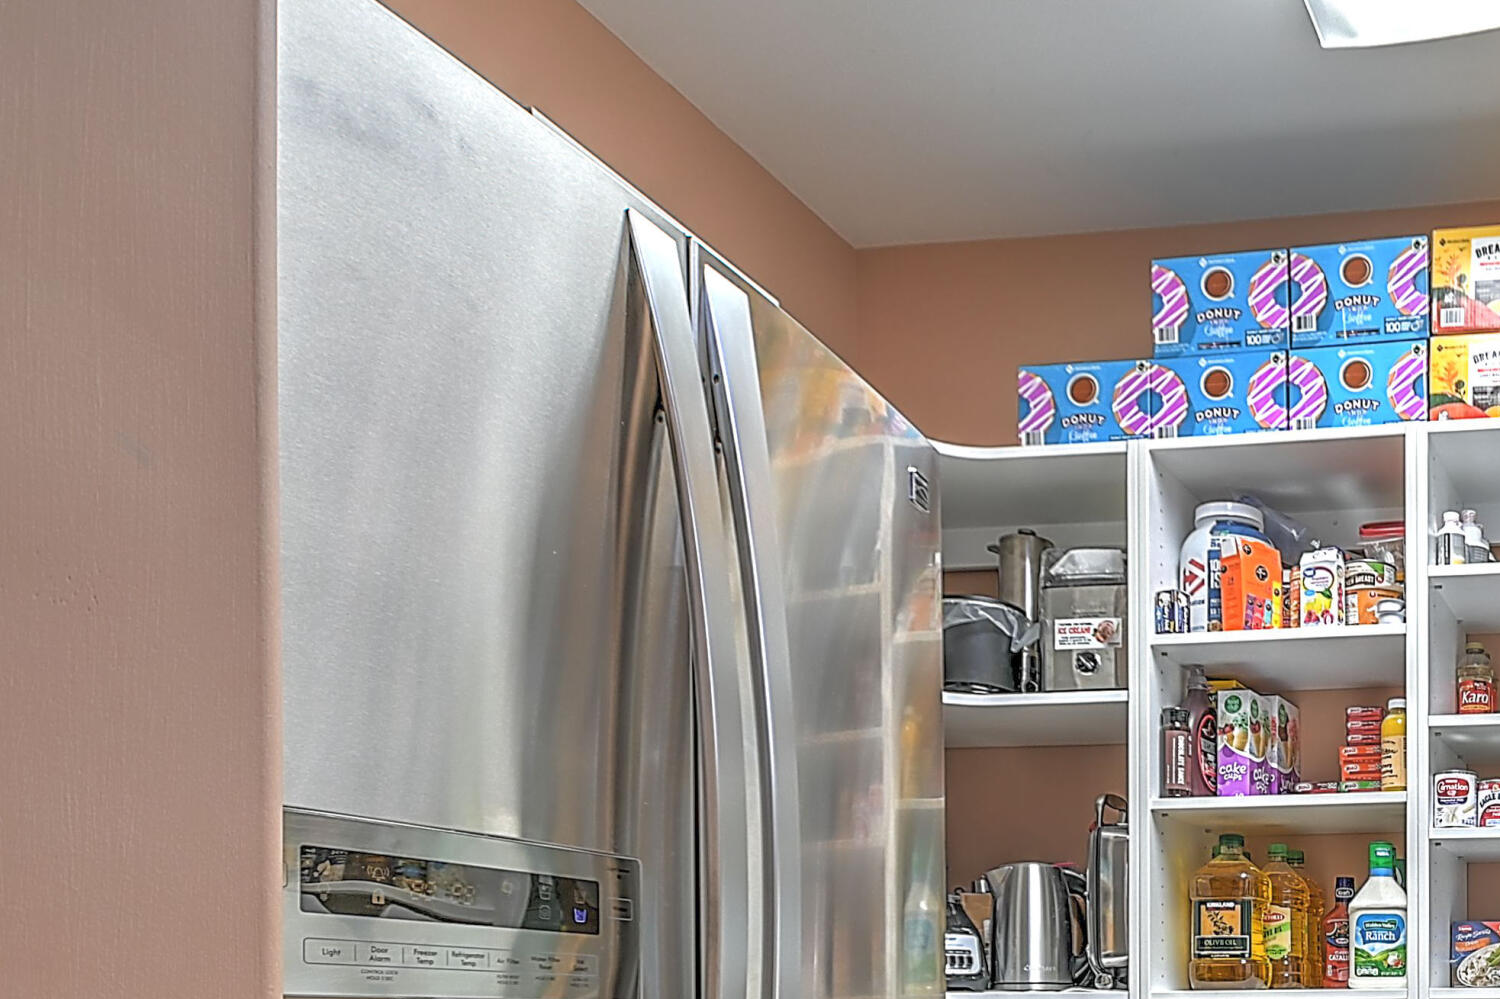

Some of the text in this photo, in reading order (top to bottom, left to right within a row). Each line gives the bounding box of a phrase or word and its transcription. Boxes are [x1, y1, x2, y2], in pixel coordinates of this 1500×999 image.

[1335, 295, 1380, 310] DONUT
[1196, 308, 1242, 323] DONUT
[1386, 322, 1400, 333] 100
[1246, 334, 1261, 345] 100
[1334, 399, 1380, 414] DONUT
[1061, 413, 1105, 428] DONUT
[1195, 408, 1240, 423] DONUT
[1462, 691, 1489, 704] Karo
[1219, 762, 1247, 775] cake
[1223, 772, 1243, 782] cups
[1438, 781, 1469, 793] Carnation
[1365, 931, 1396, 941] Ranch
[321, 948, 342, 958] Light
[370, 945, 389, 954] Door
